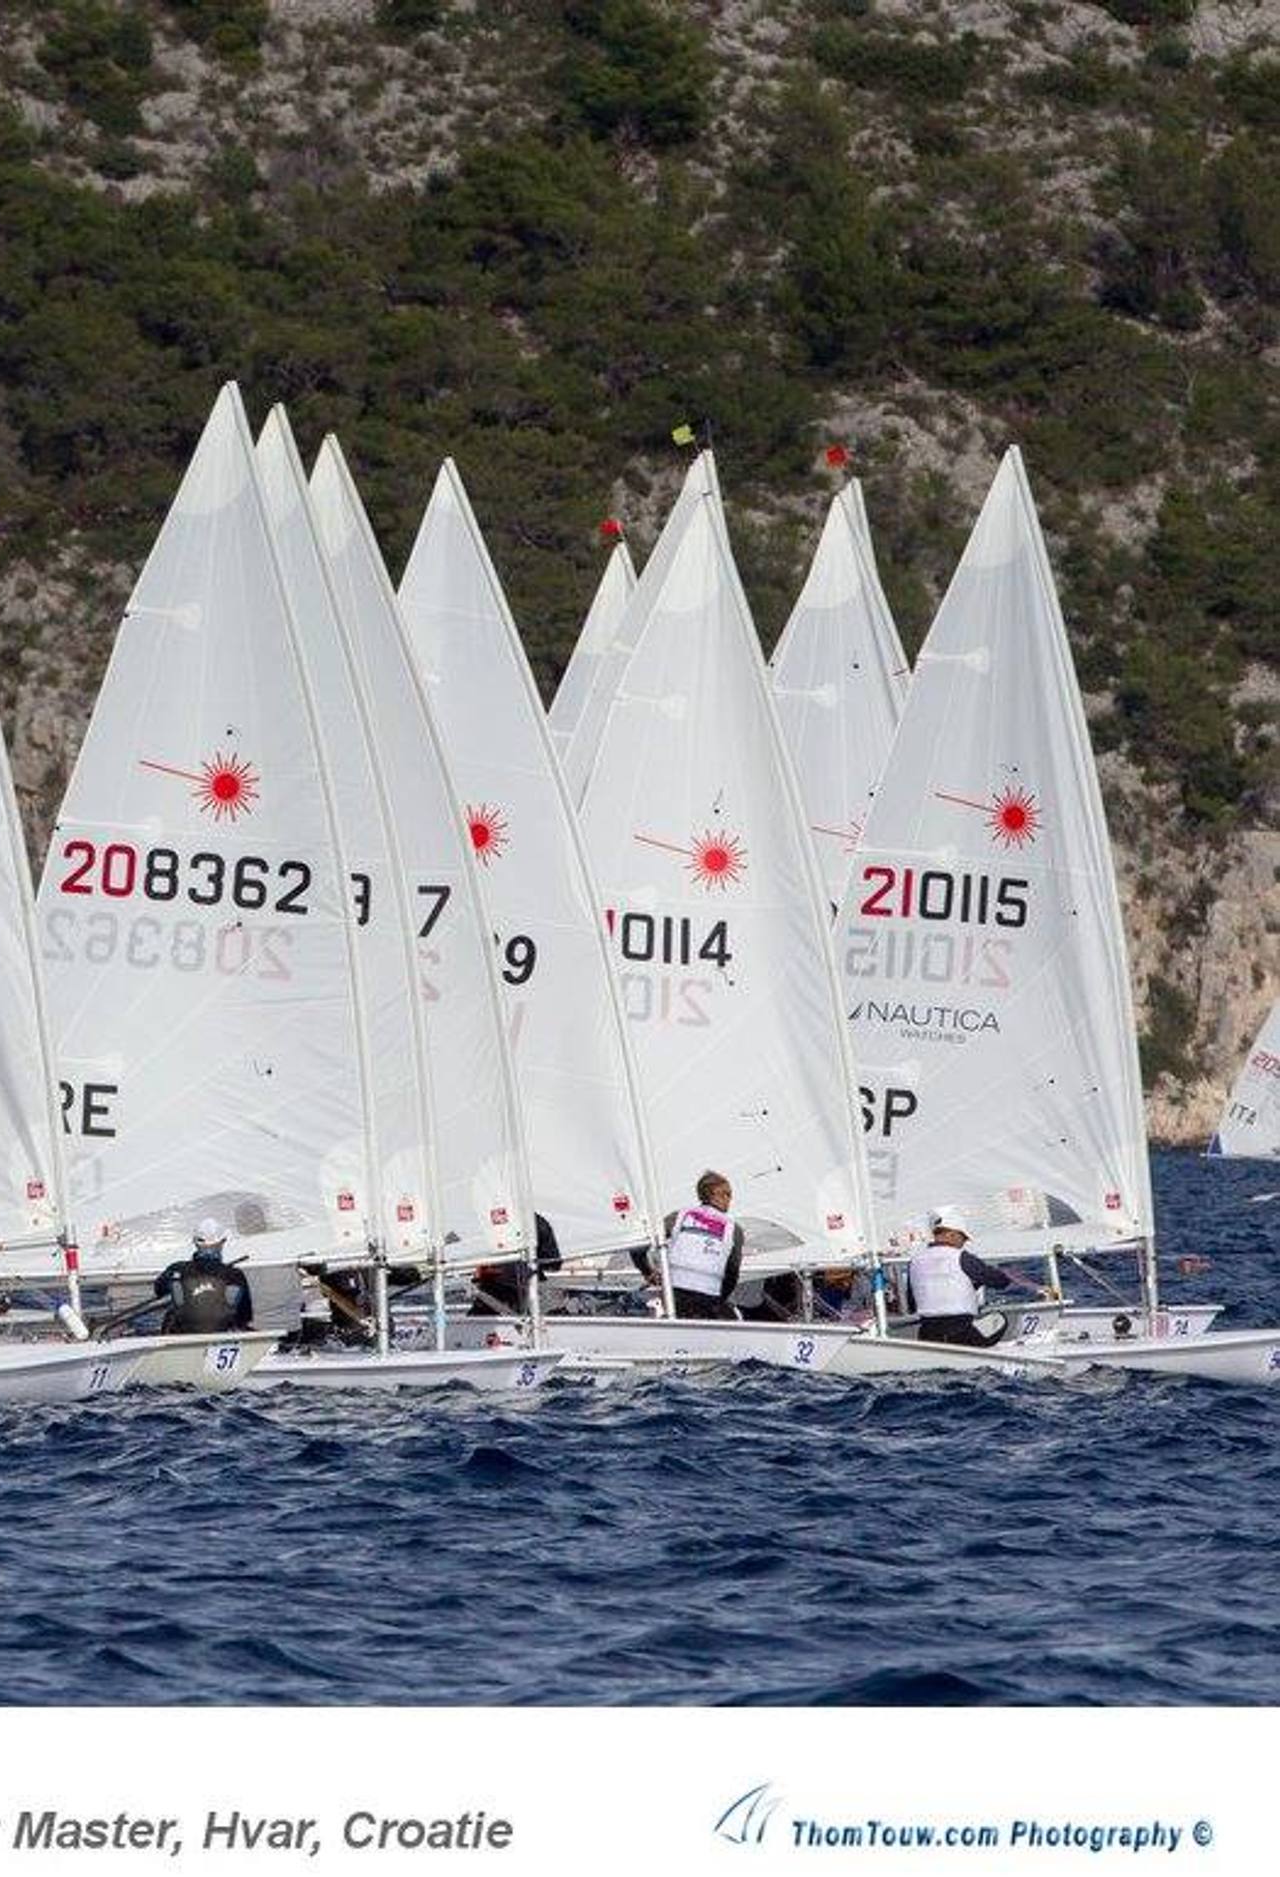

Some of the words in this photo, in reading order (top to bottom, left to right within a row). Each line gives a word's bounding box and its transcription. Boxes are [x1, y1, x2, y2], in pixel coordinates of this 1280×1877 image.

[60, 841, 312, 915] 208362
[860, 867, 1028, 928] 210115
[417, 885, 451, 938] 7
[493, 932, 537, 986] 9
[868, 1001, 1001, 1033] NAUTICA
[216, 1347, 240, 1370] 57
